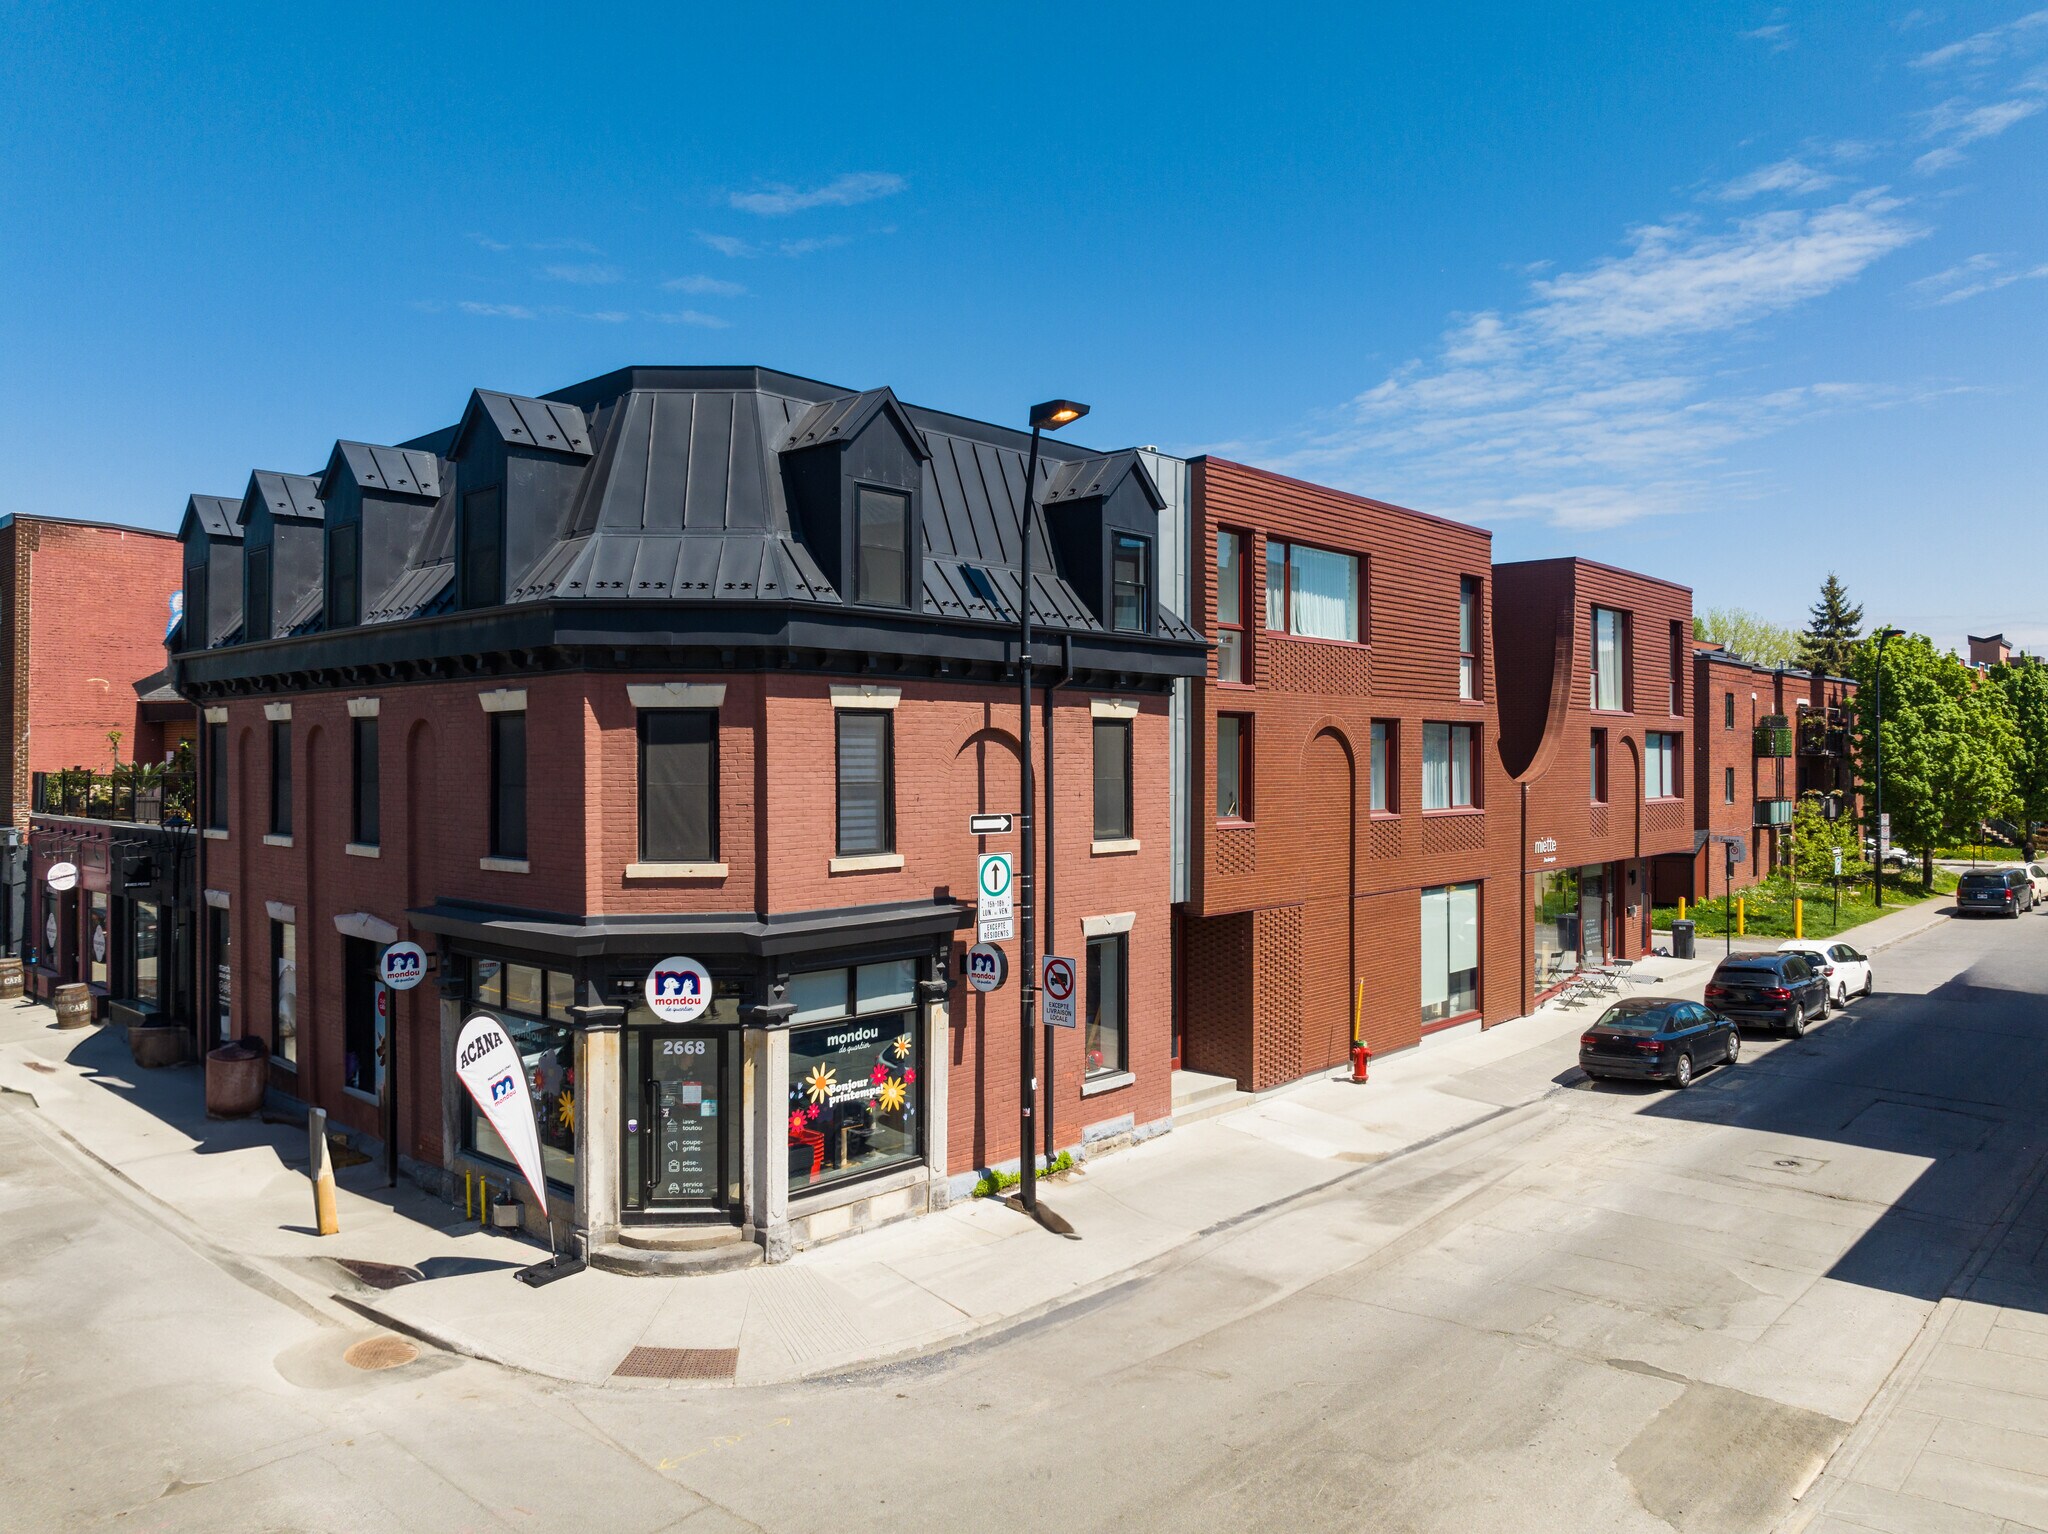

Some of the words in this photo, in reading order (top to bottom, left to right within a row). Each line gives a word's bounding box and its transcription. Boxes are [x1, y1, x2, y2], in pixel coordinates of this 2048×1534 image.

[1534, 837, 1557, 853] miette
[4, 974, 22, 984] CAFÉ
[388, 970, 420, 978] mondou
[69, 1000, 88, 1012] CAFÉ
[655, 997, 701, 1005] mondou
[1046, 1008, 1072, 1016] LIVRAISON
[1050, 1014, 1068, 1022] LOCALE
[827, 1027, 878, 1046] mondou
[461, 1032, 504, 1070] ACANA
[664, 1041, 705, 1054] 2668
[838, 1044, 846, 1054] de
[847, 1041, 872, 1054] quartier
[828, 1078, 868, 1094] Bonjour
[494, 1090, 516, 1108] mondou
[828, 1083, 884, 1108] printemps!
